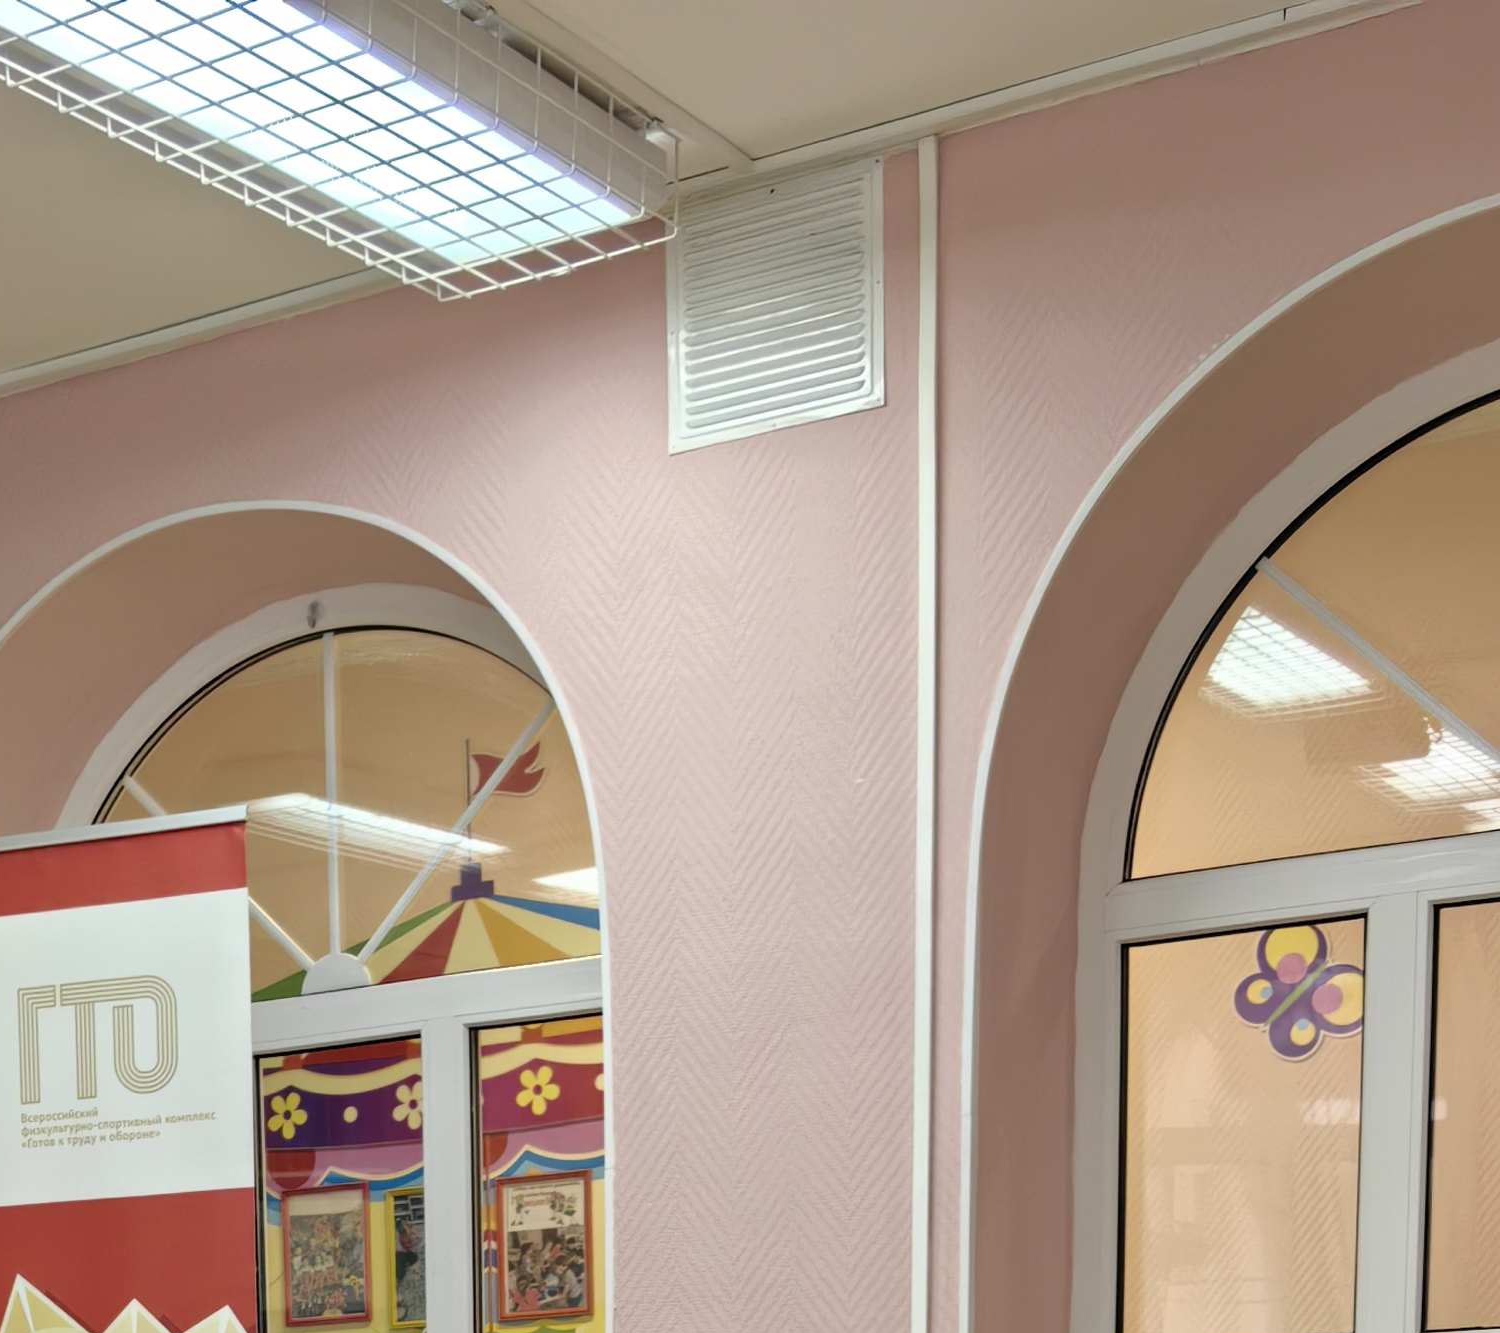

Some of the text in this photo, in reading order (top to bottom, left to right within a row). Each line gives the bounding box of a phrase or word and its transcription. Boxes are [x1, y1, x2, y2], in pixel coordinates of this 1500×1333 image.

[17, 975, 178, 1105] ГТО
[20, 1107, 99, 1124] Всероссийский
[21, 1110, 217, 1138] физкультурно-спортивный комплекс
[58, 1137, 65, 1146] к
[67, 1133, 97, 1147] труду
[100, 1133, 106, 1142] и
